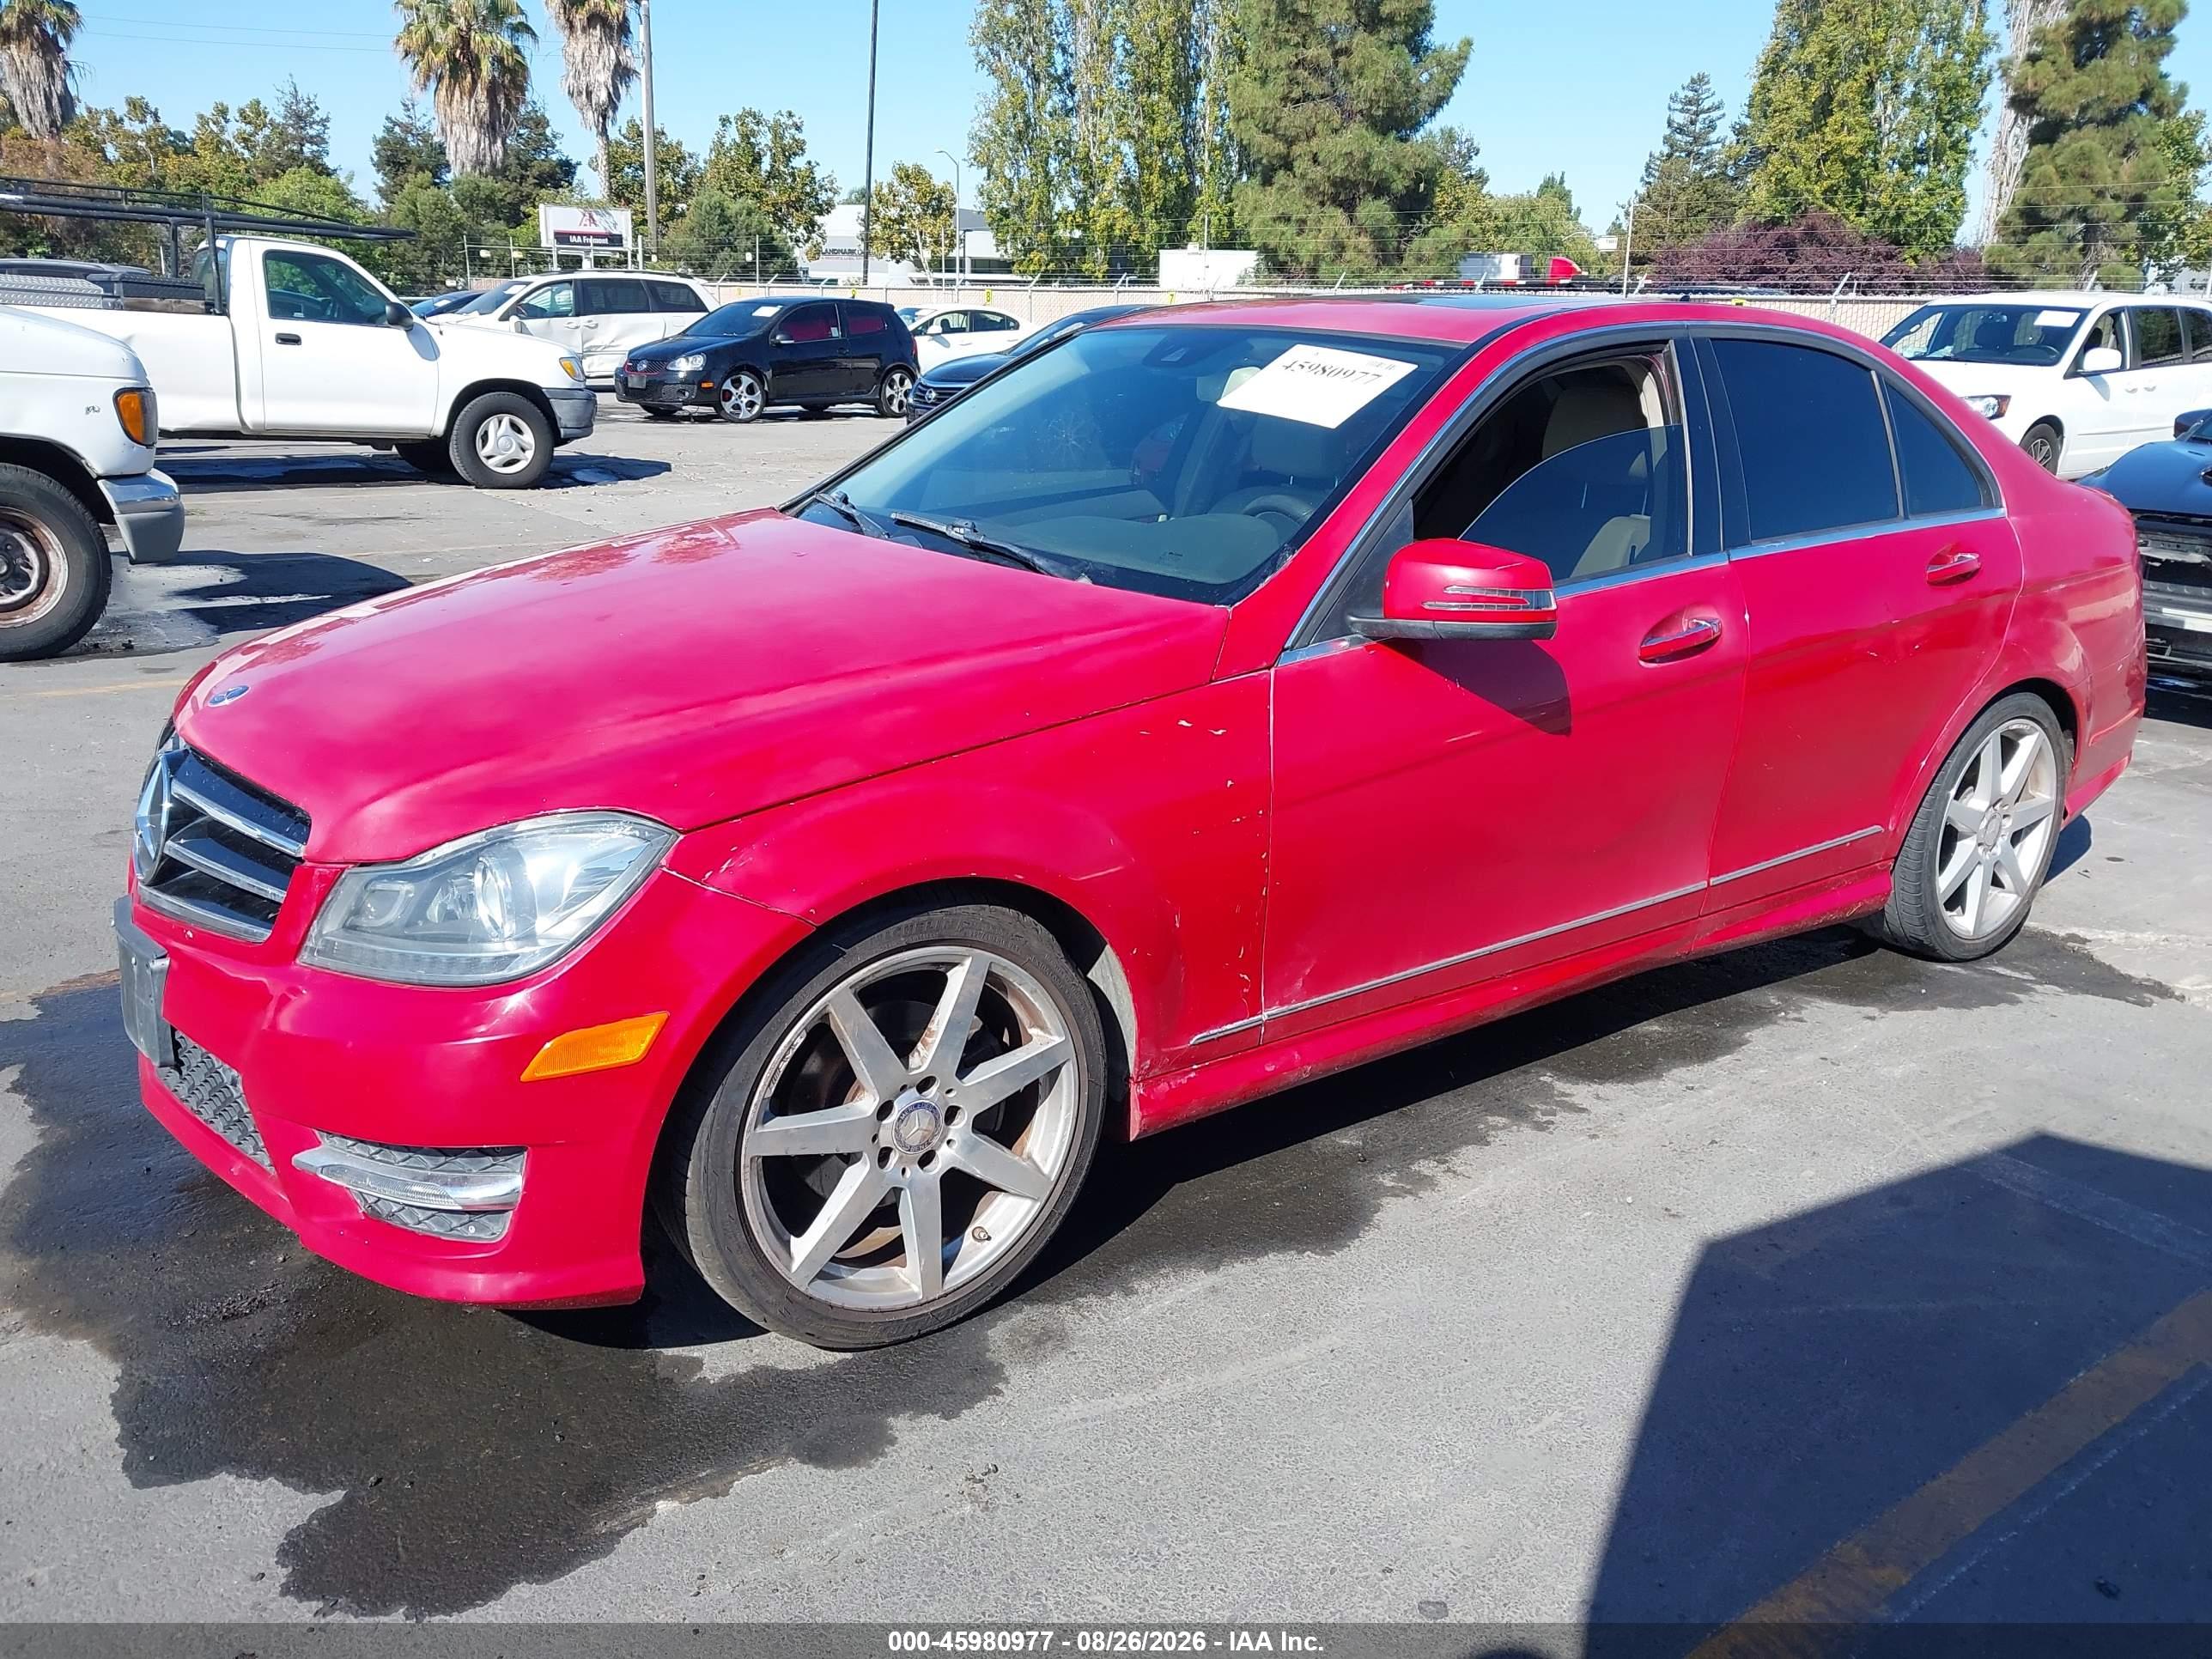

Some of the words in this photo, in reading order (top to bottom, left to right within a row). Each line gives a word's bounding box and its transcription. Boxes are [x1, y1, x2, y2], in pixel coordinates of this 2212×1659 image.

[569, 234, 581, 243] IAA
[583, 235, 609, 244] Frmont
[1282, 360, 1383, 385] 45980977
